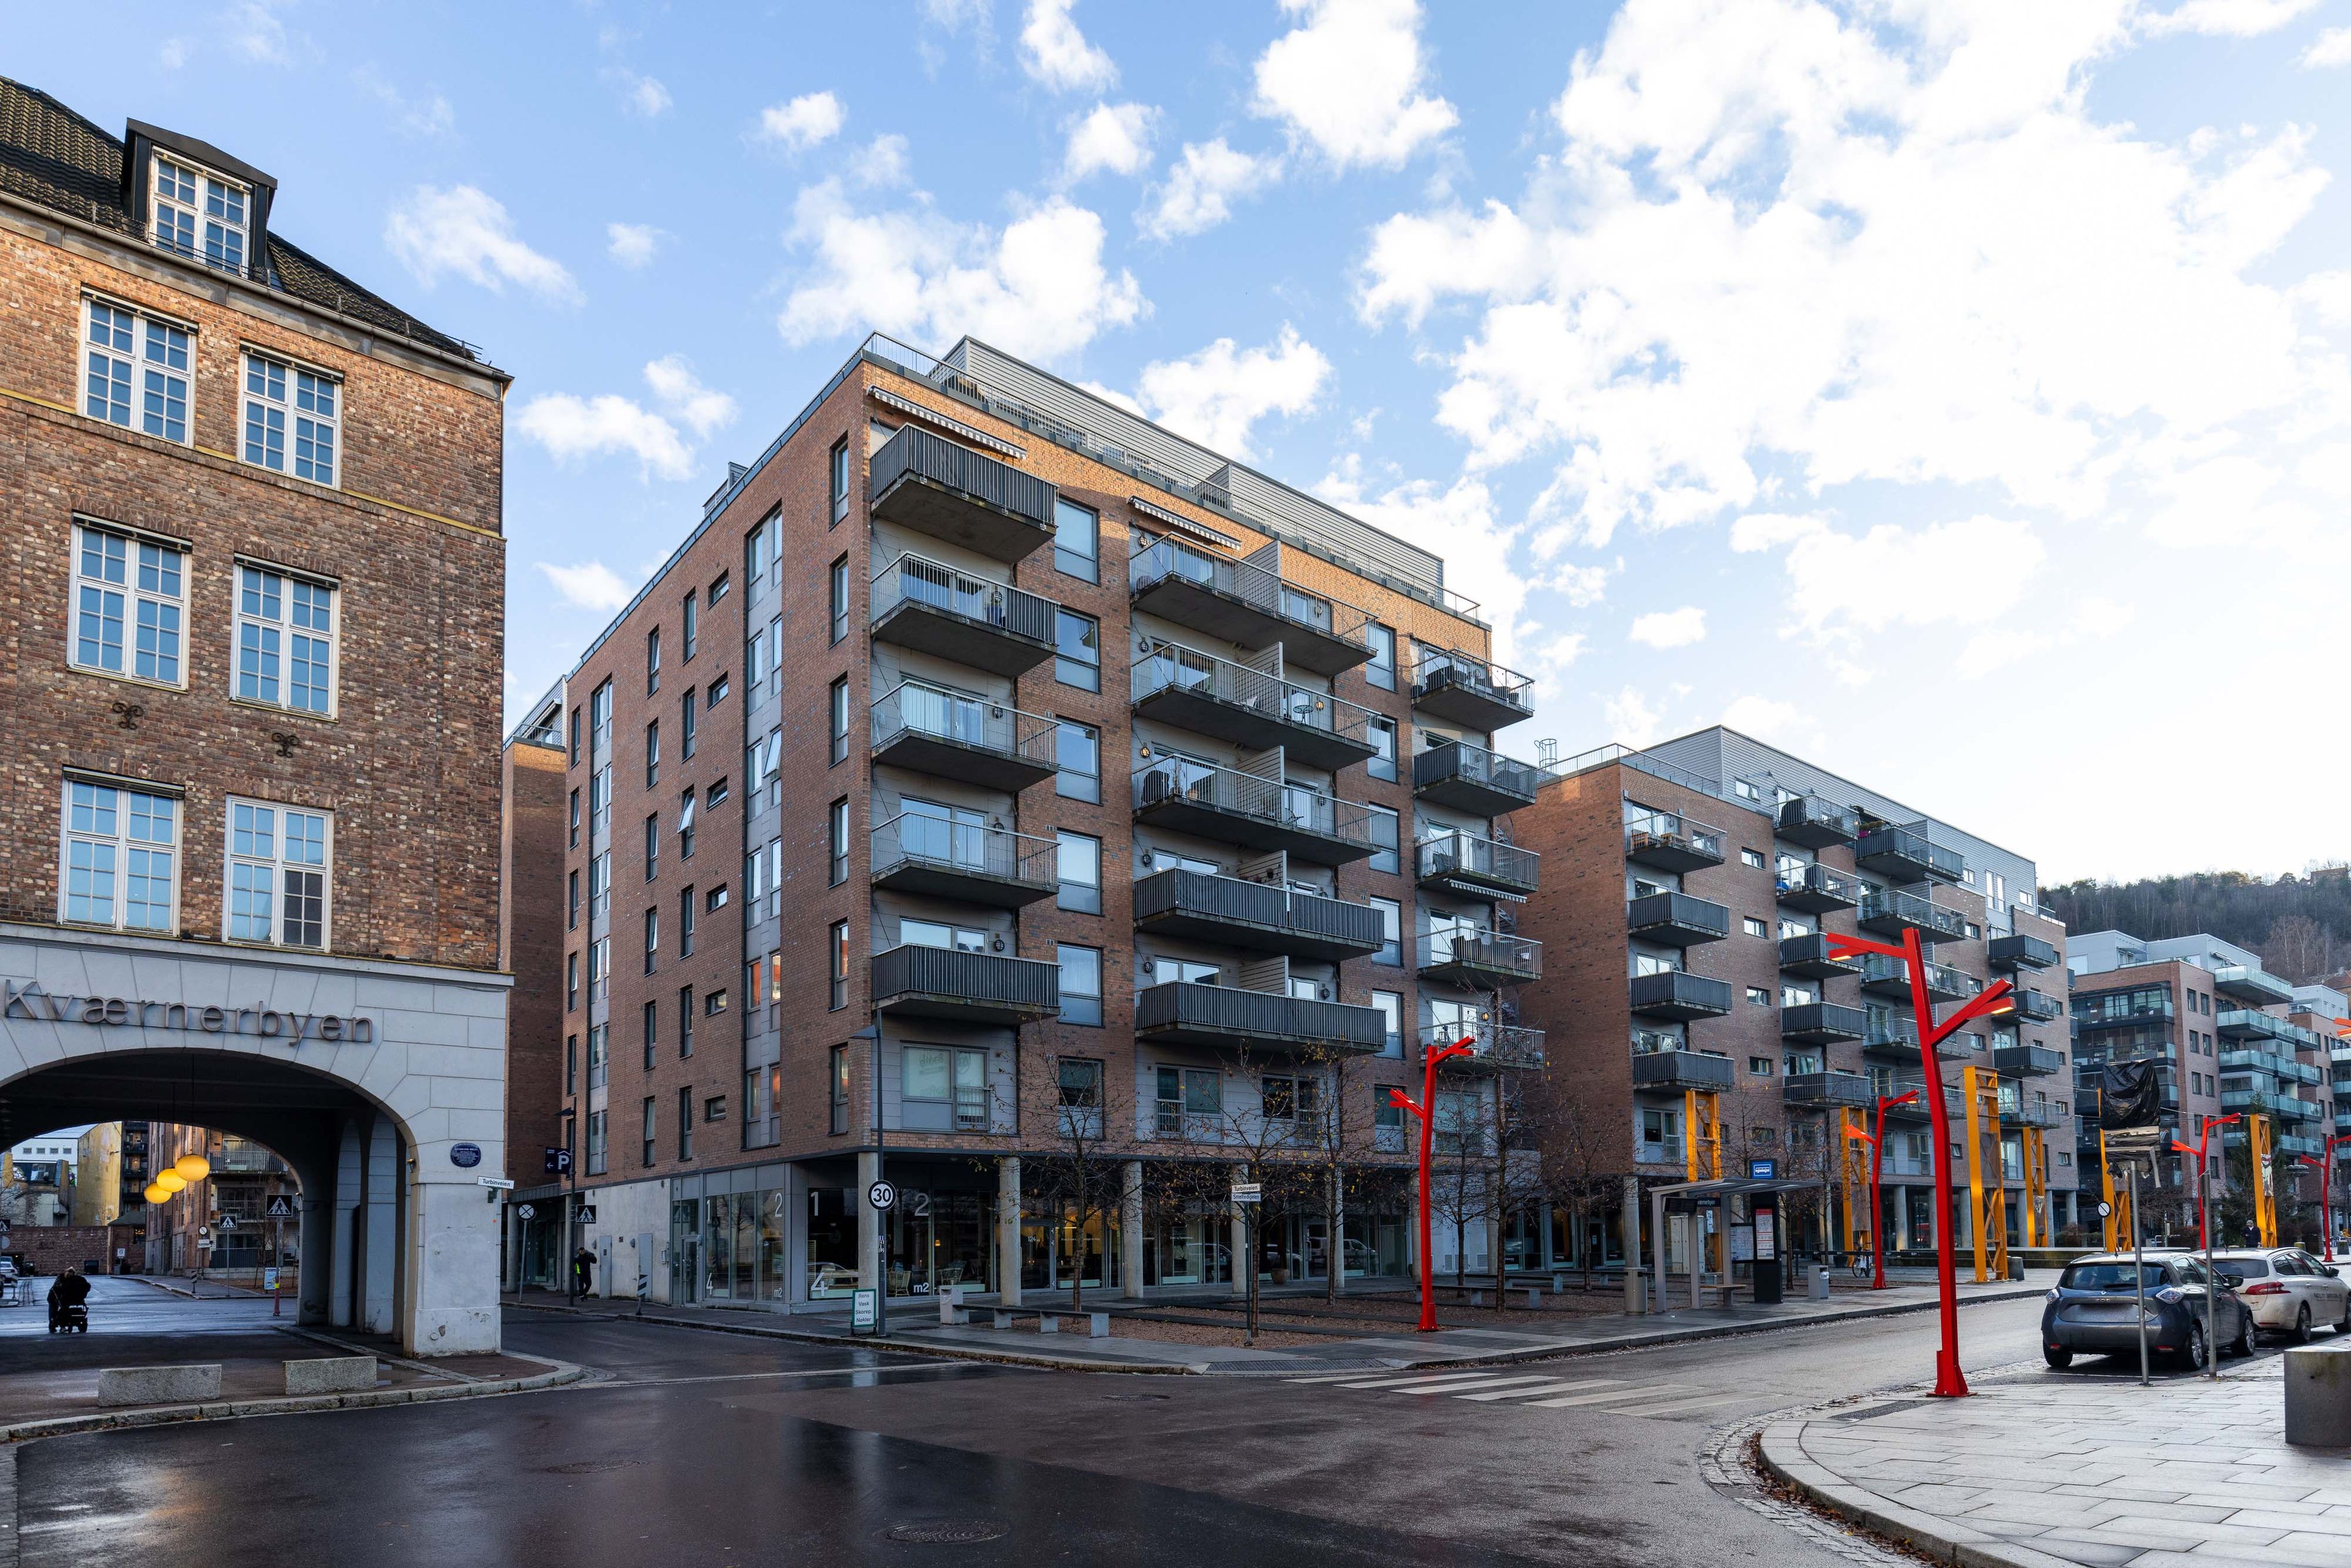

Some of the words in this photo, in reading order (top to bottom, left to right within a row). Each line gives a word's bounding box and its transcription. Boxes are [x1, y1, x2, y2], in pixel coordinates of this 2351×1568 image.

[5, 980, 373, 1046] Kværnerbyen
[558, 1155, 569, 1170] P
[482, 1178, 511, 1187] Turbinveien
[873, 1188, 891, 1202] 30
[707, 1199, 711, 1222] 1
[774, 1192, 782, 1218] 2
[811, 1191, 819, 1216] 1
[914, 1193, 929, 1216] 2
[706, 1273, 713, 1295] 4
[774, 1287, 782, 1298] m2
[811, 1272, 828, 1297] 4
[913, 1282, 929, 1293] m2
